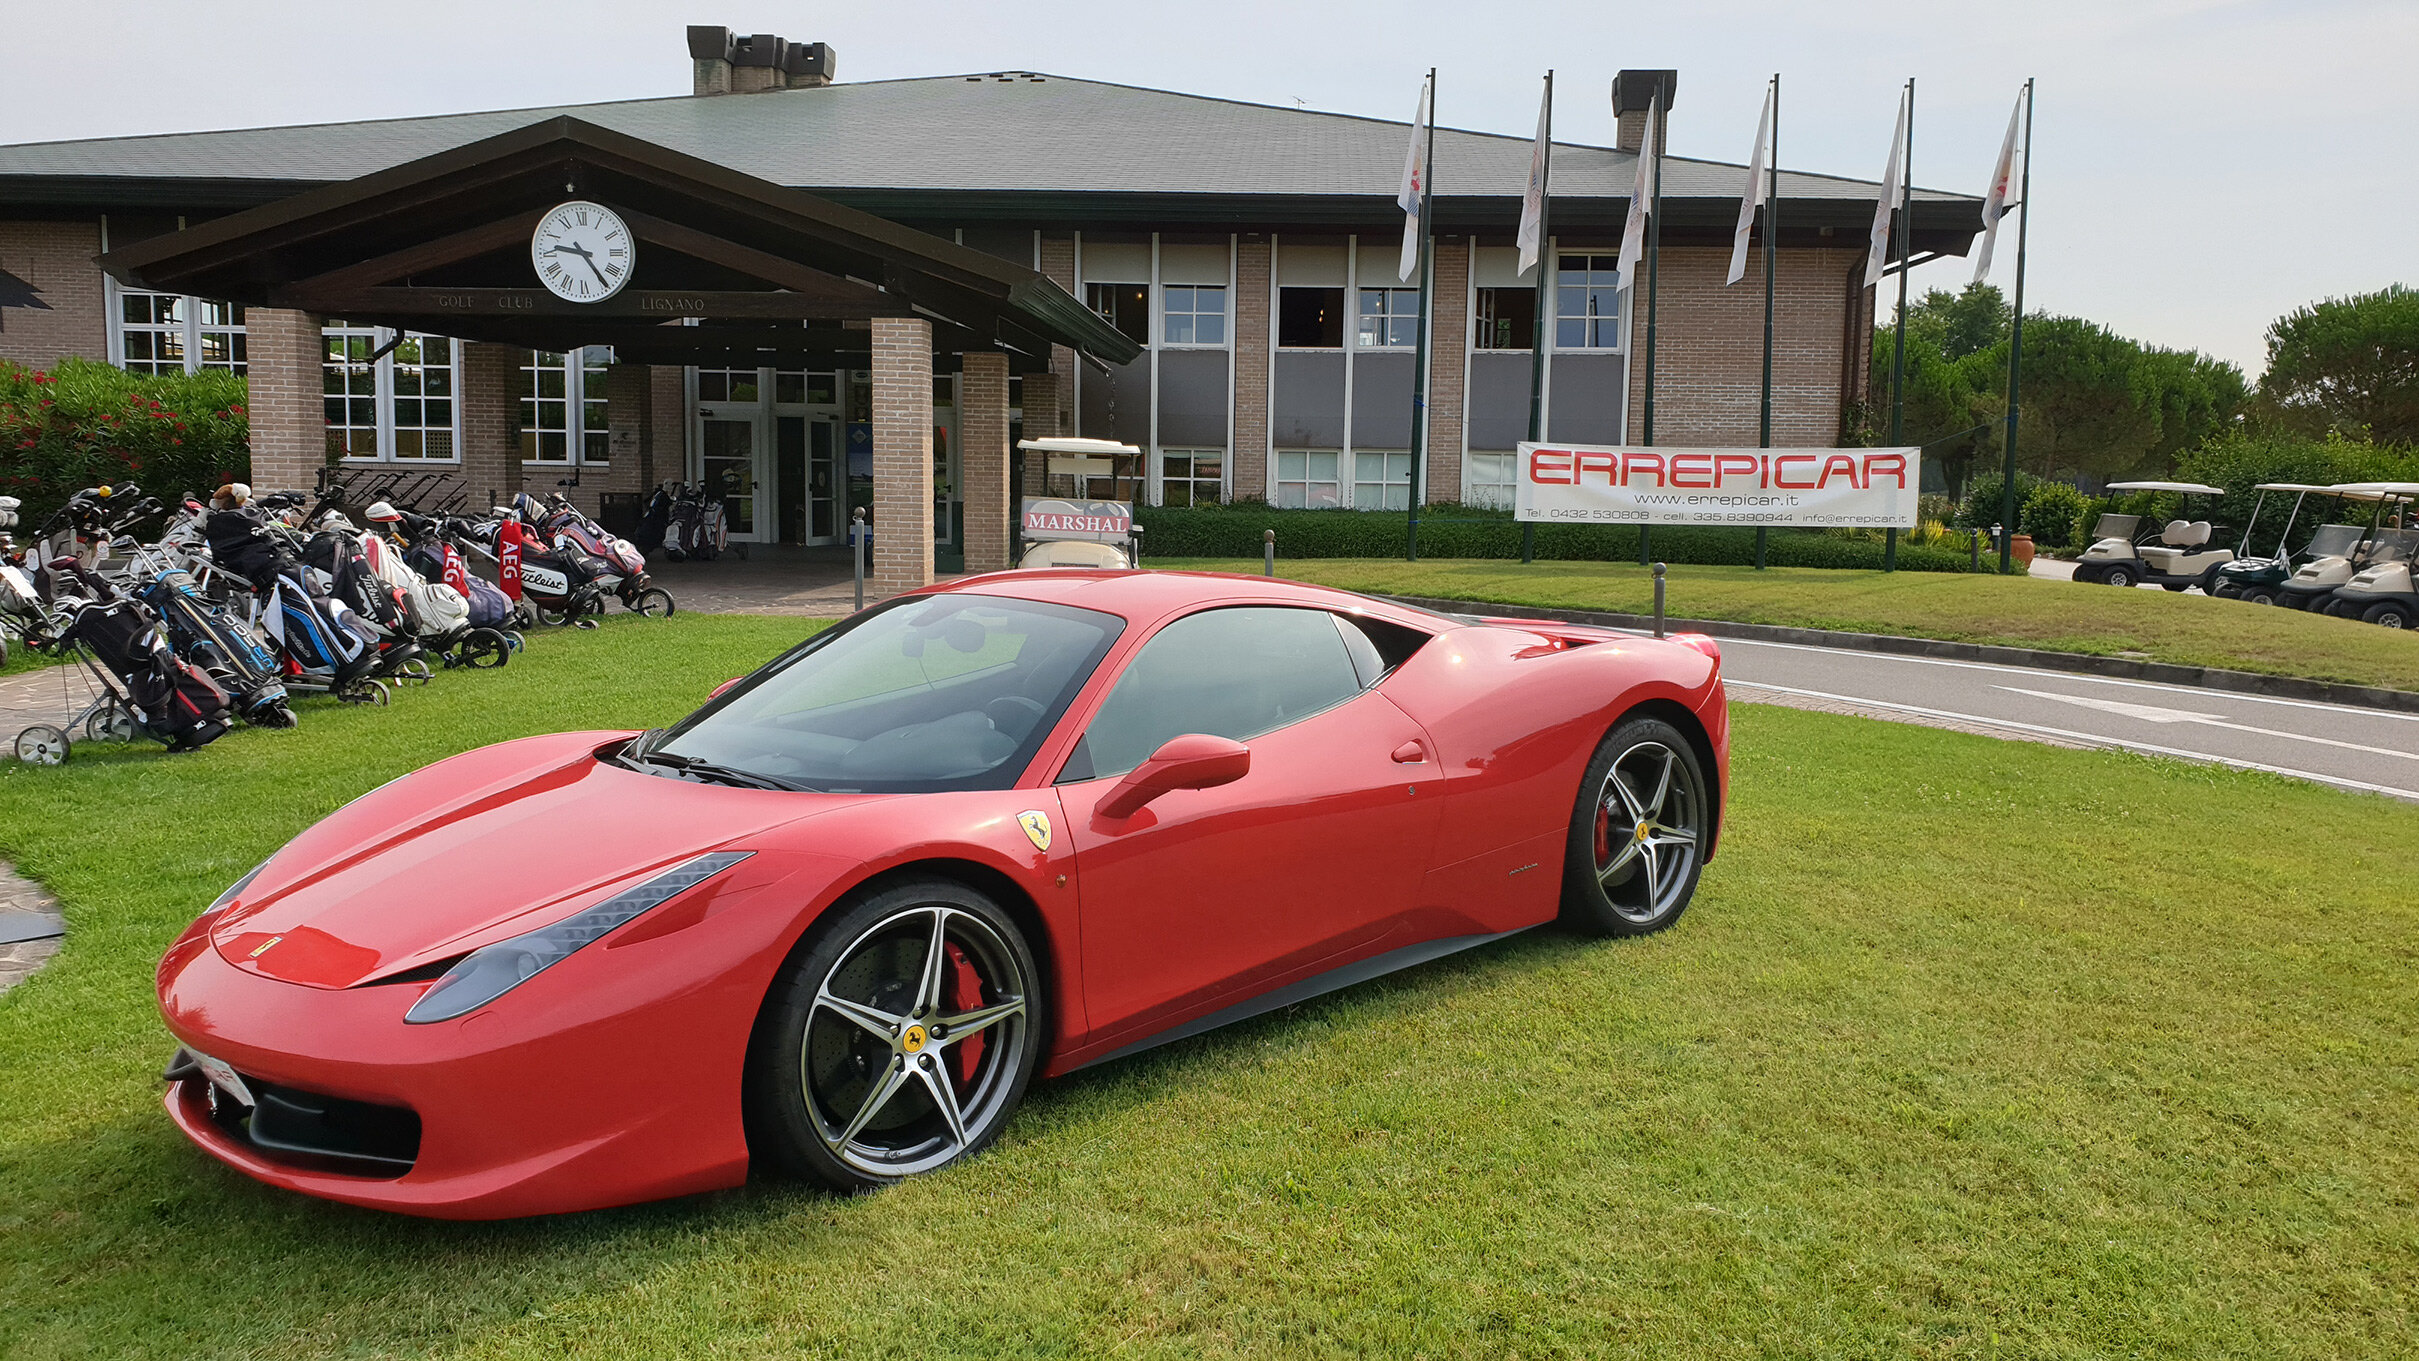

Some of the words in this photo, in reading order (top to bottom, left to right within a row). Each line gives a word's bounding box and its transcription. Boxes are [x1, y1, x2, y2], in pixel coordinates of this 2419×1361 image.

[439, 295, 474, 308] GOLF
[499, 296, 533, 309] CLUB
[642, 298, 705, 312] LIGNANO
[1529, 449, 1907, 490] ERREPICAR
[1634, 493, 1799, 507] www.errepicar.it
[1028, 513, 1127, 533] MARSHAL
[1525, 508, 1545, 518] Tel.
[1550, 508, 1588, 519] 0432
[1592, 510, 1650, 520] 530808
[1663, 512, 1688, 521] cell.
[1693, 512, 1793, 522] 335.8390944
[1802, 513, 1907, 524] info@errepicar.it
[502, 540, 519, 579] AEG
